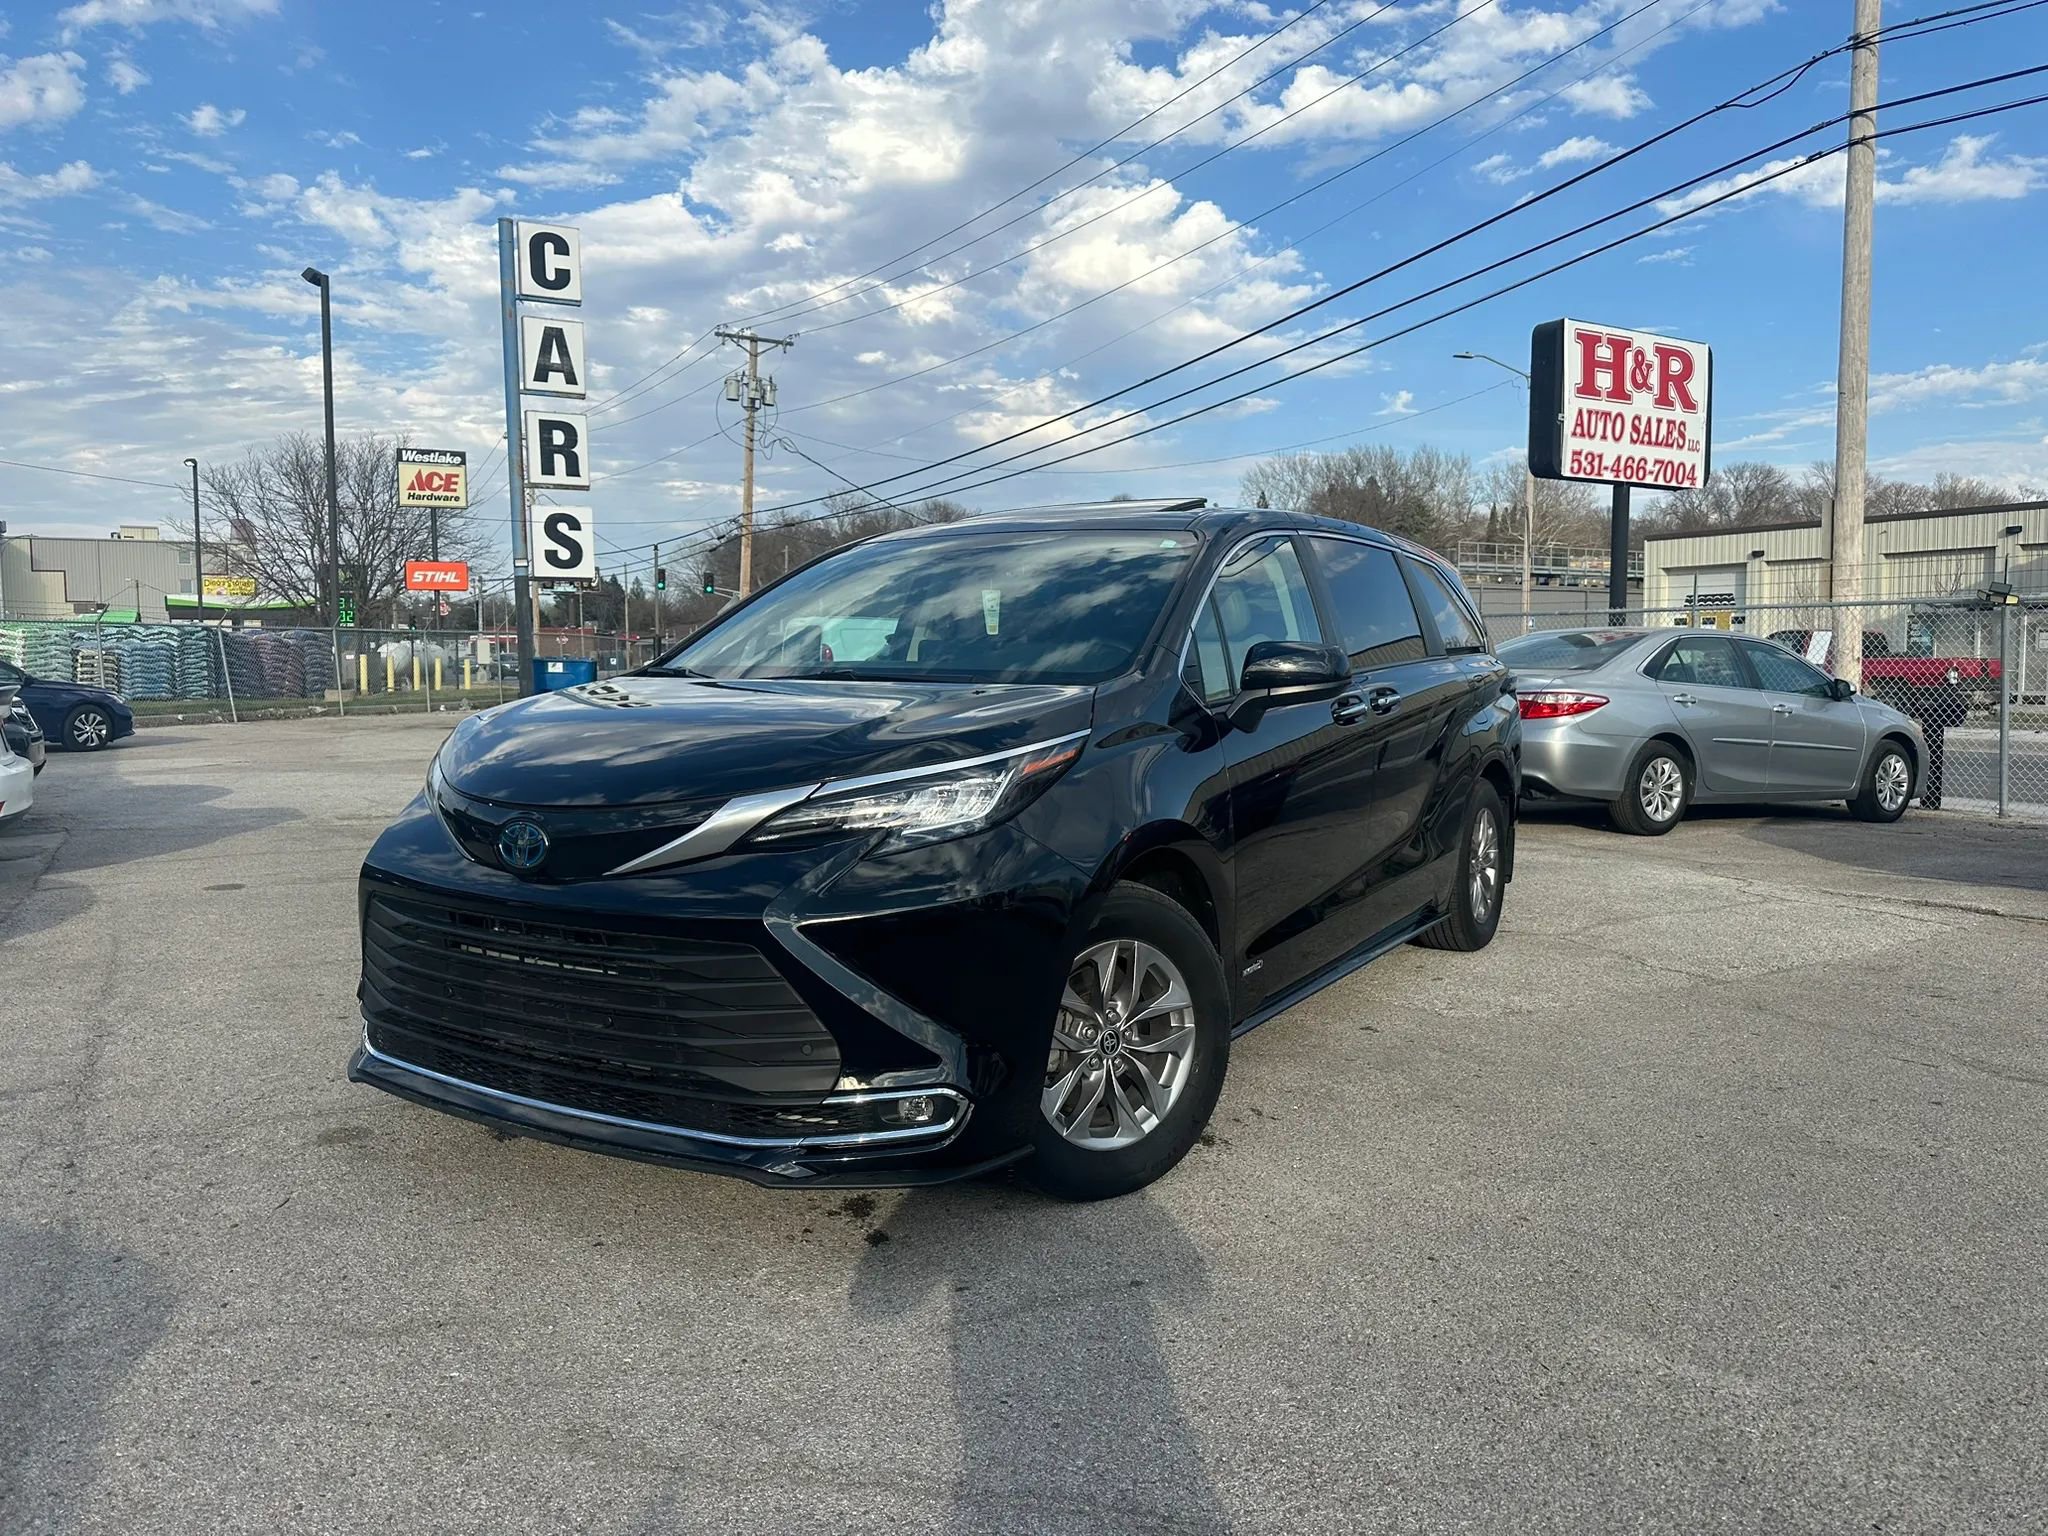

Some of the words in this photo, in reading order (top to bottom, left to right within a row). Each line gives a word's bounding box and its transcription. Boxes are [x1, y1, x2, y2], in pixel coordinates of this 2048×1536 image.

[1575, 328, 1698, 414] H&R
[529, 231, 583, 569] CARS
[1571, 408, 1625, 442] AUTO
[1630, 414, 1687, 450] SALES
[1687, 439, 1701, 453] LLC
[402, 450, 462, 465] Westlake
[1570, 449, 1697, 486] 531-466-7004
[407, 469, 460, 492] ACE
[407, 492, 461, 502] Hardware
[412, 571, 461, 583] STIHL
